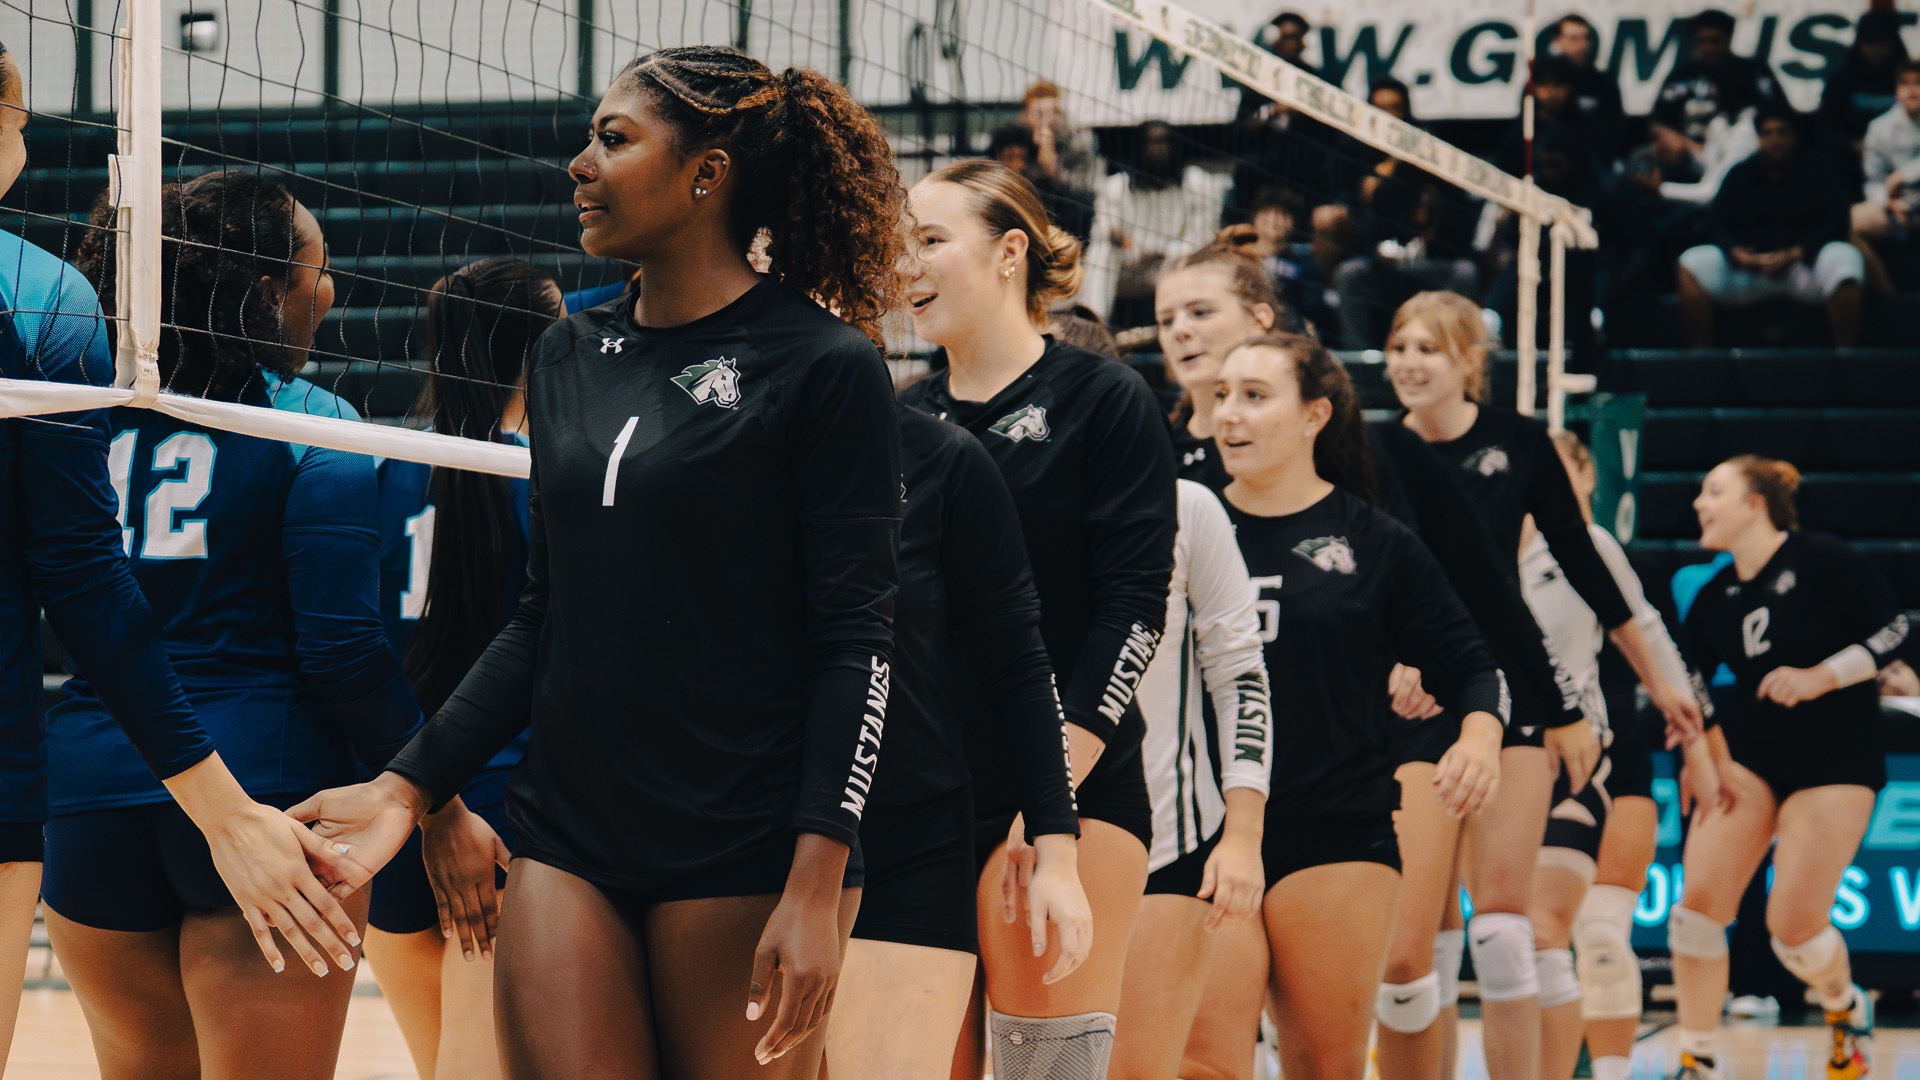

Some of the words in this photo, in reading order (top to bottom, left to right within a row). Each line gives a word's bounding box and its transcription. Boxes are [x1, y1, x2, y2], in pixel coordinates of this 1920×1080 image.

[109, 428, 217, 559] 12
[602, 416, 639, 506] 1
[840, 655, 890, 821] MUSTANGS
